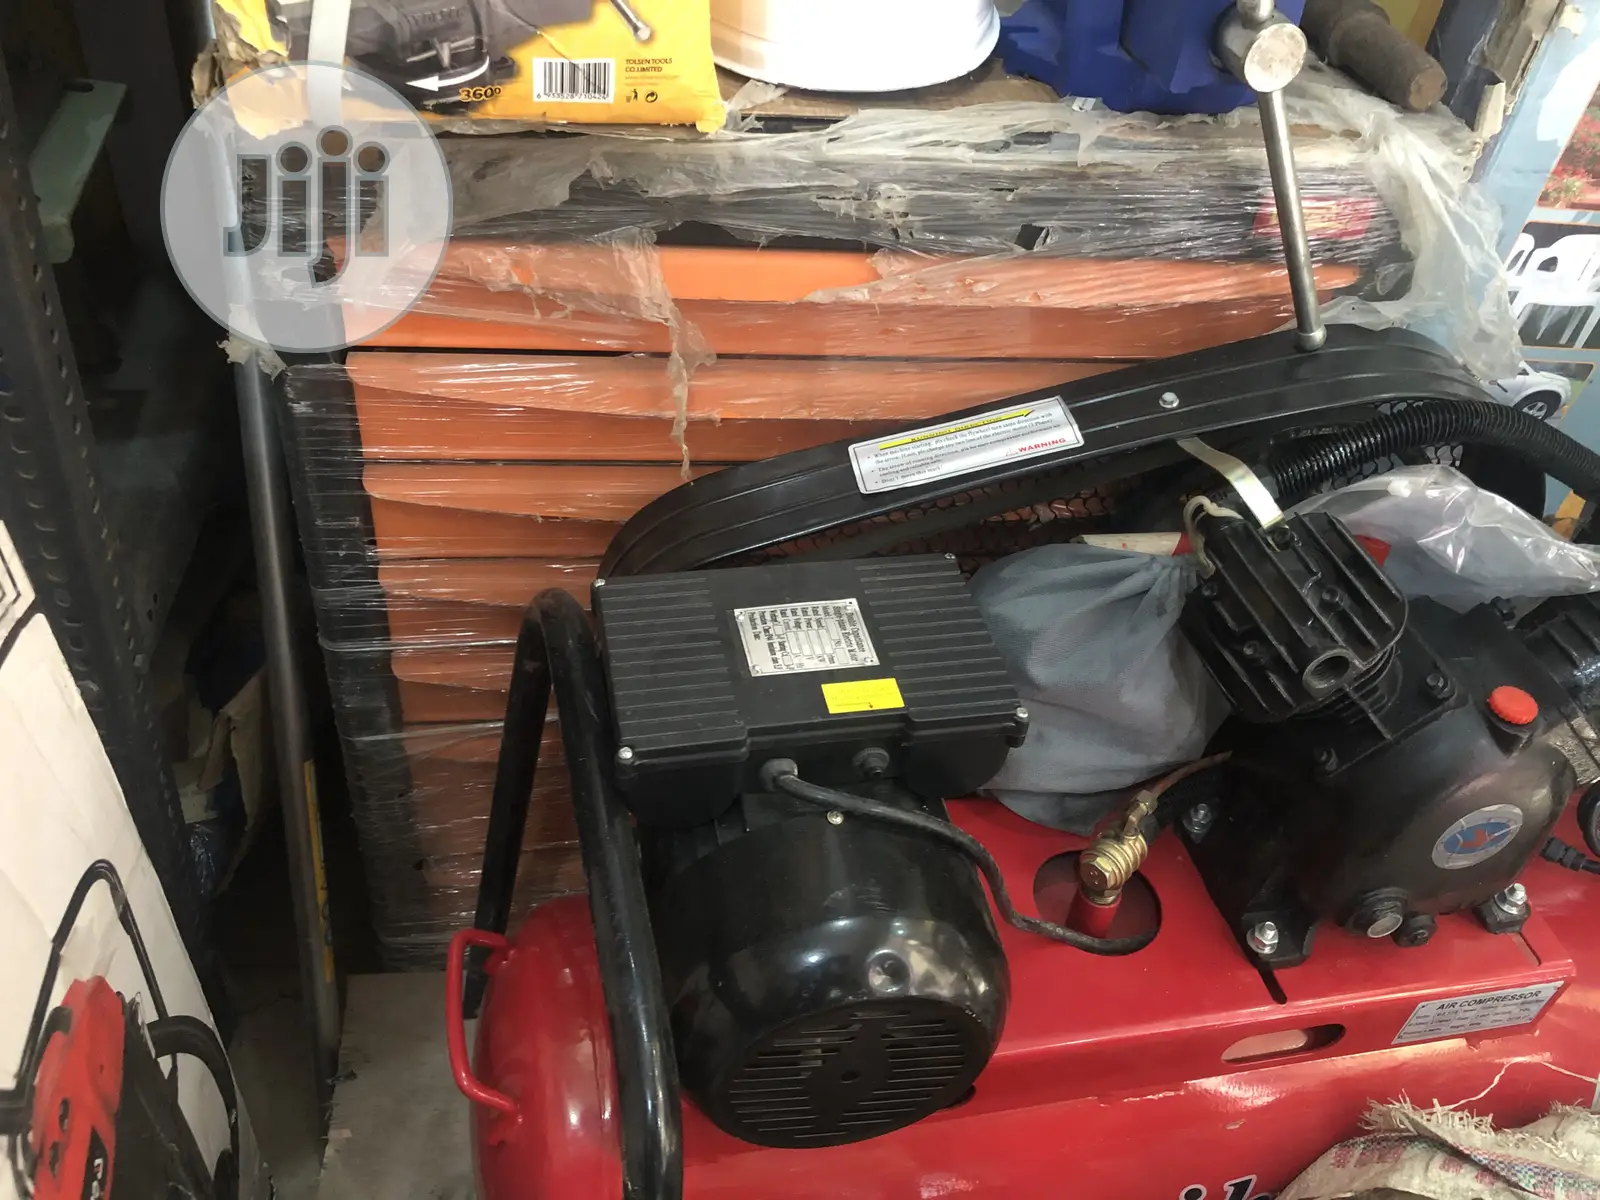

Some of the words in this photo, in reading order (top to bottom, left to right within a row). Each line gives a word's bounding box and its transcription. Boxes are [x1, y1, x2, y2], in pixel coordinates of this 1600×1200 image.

[1018, 437, 1067, 453] WARNING
[1435, 1001, 1458, 1011] AIR
[1457, 990, 1542, 1008] COMPRESSOR
